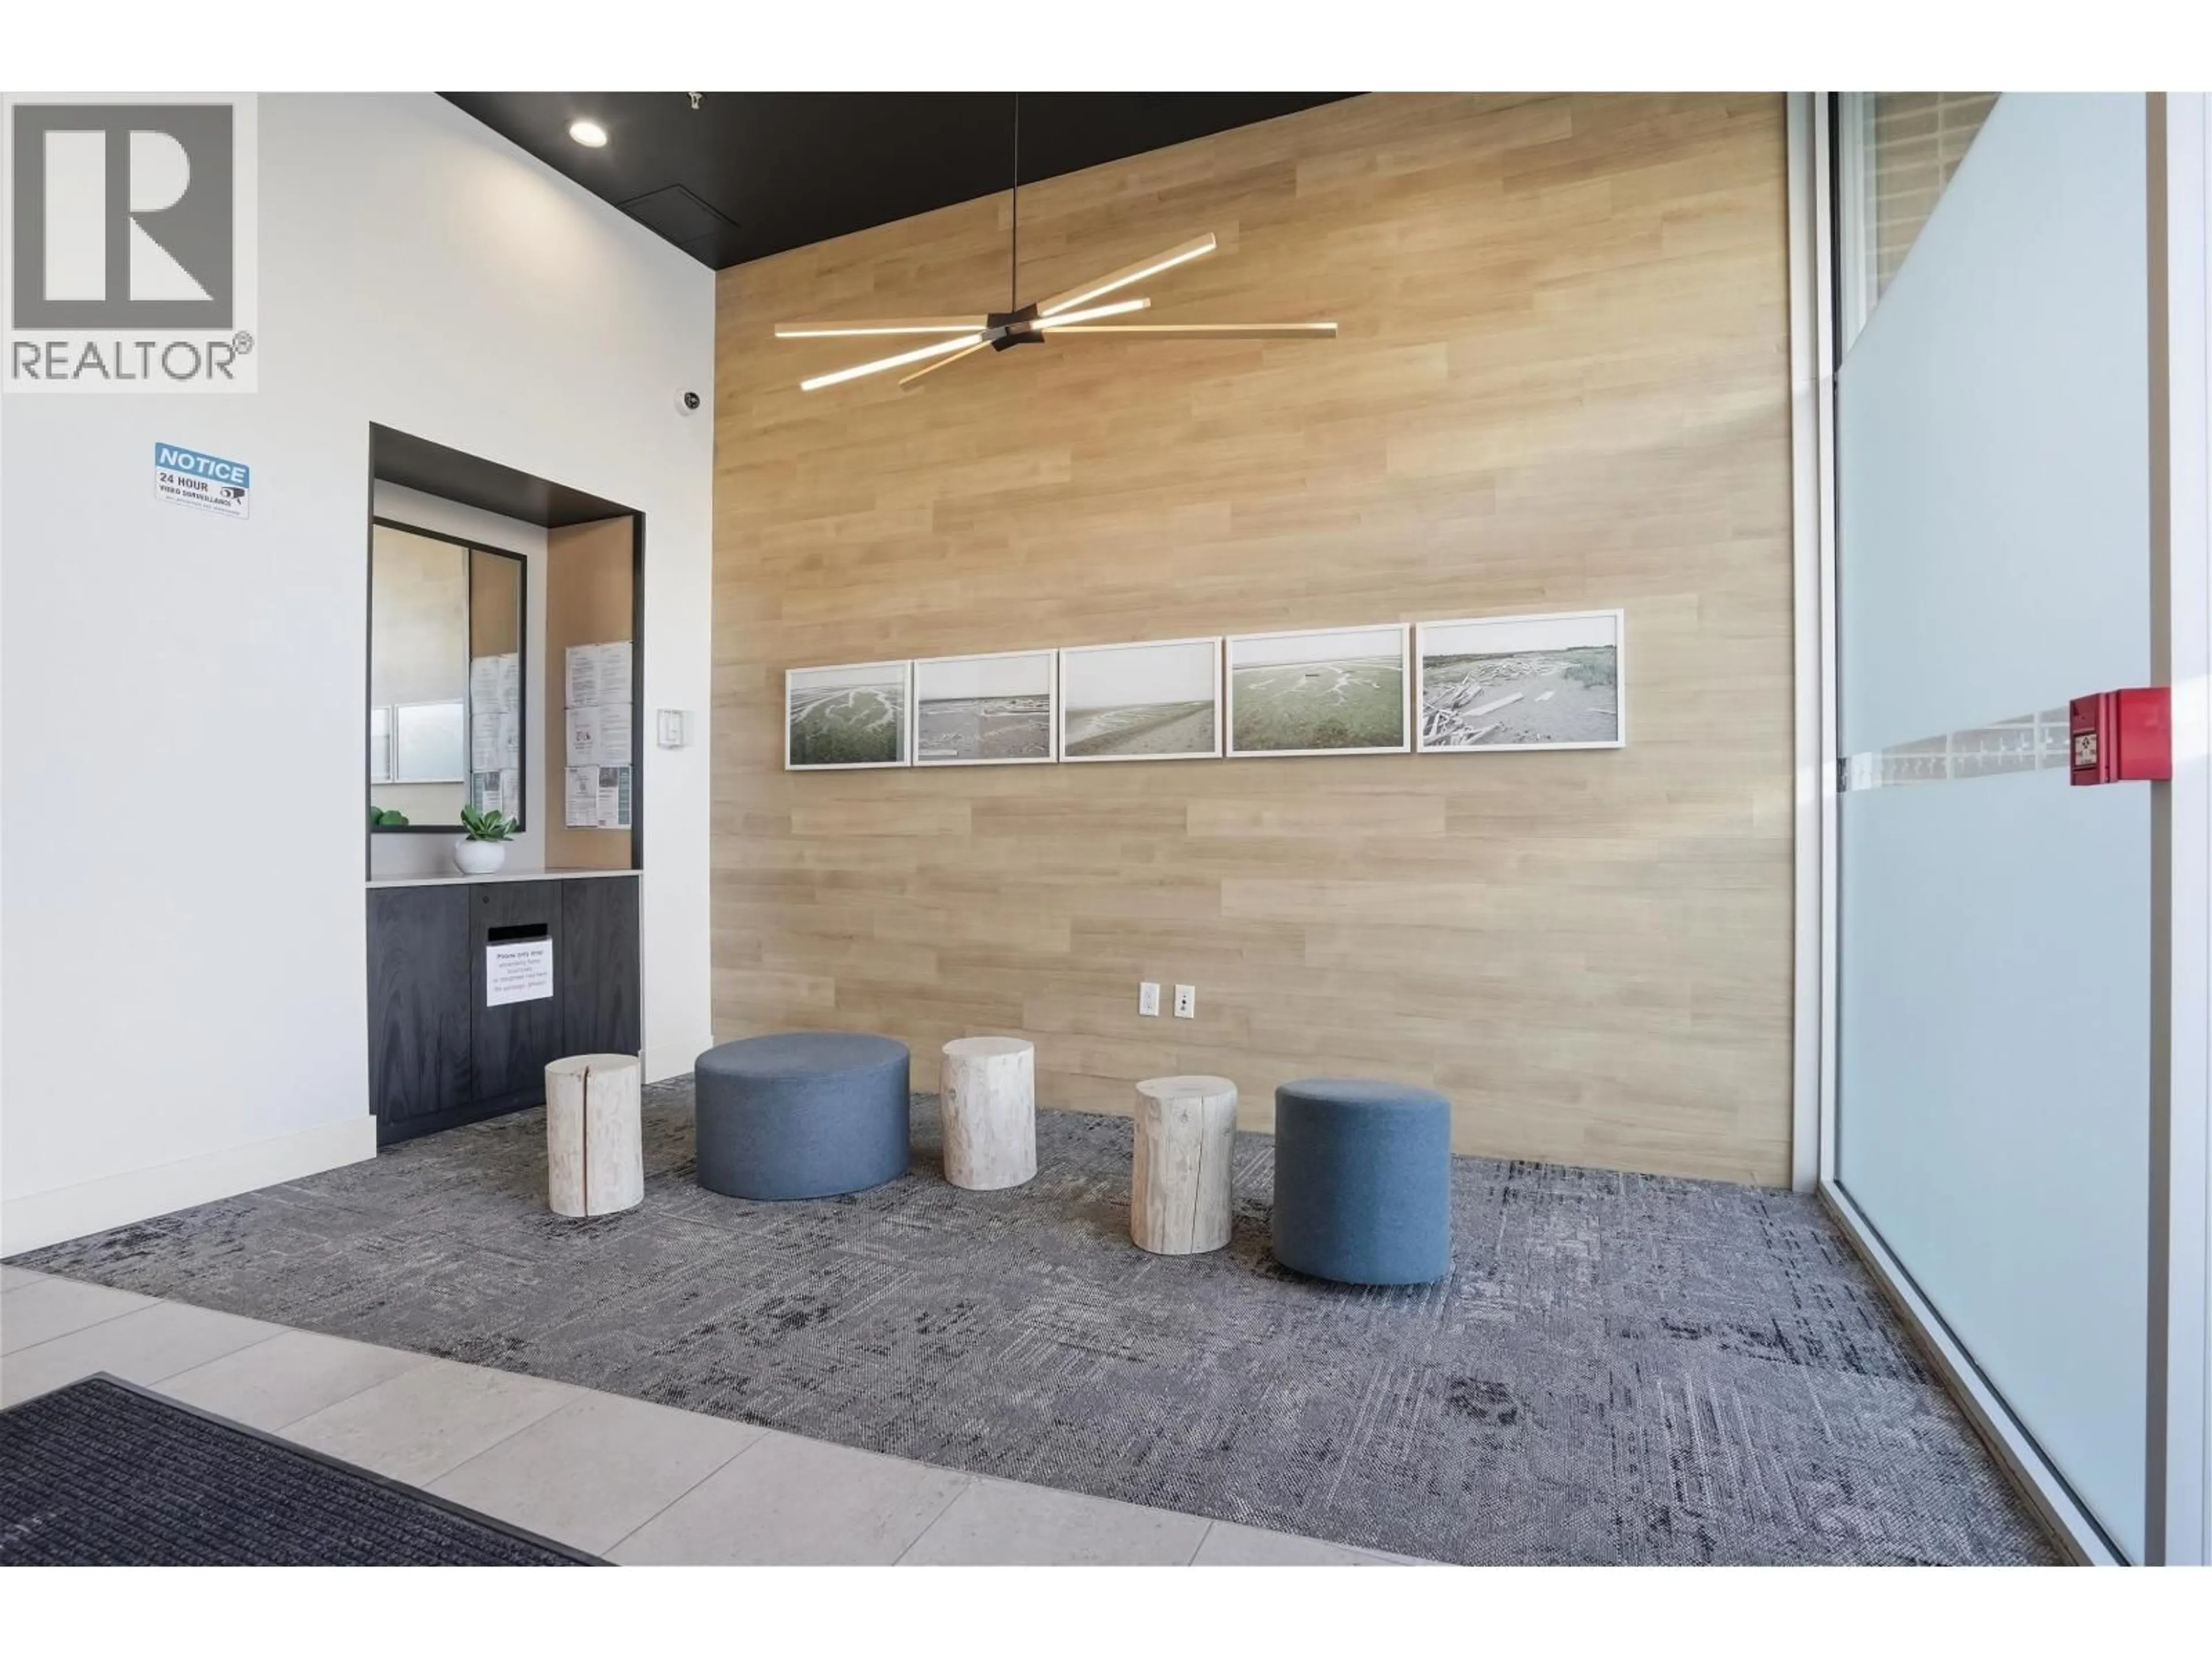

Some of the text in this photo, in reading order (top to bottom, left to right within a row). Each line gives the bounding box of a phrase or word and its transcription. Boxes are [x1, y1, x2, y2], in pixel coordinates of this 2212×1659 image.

[160, 448, 246, 483] NOTICE
[159, 472, 209, 492] 24 HOUR
[160, 484, 181, 495] VIDEO
[182, 490, 232, 507] SURVEILLANCE
